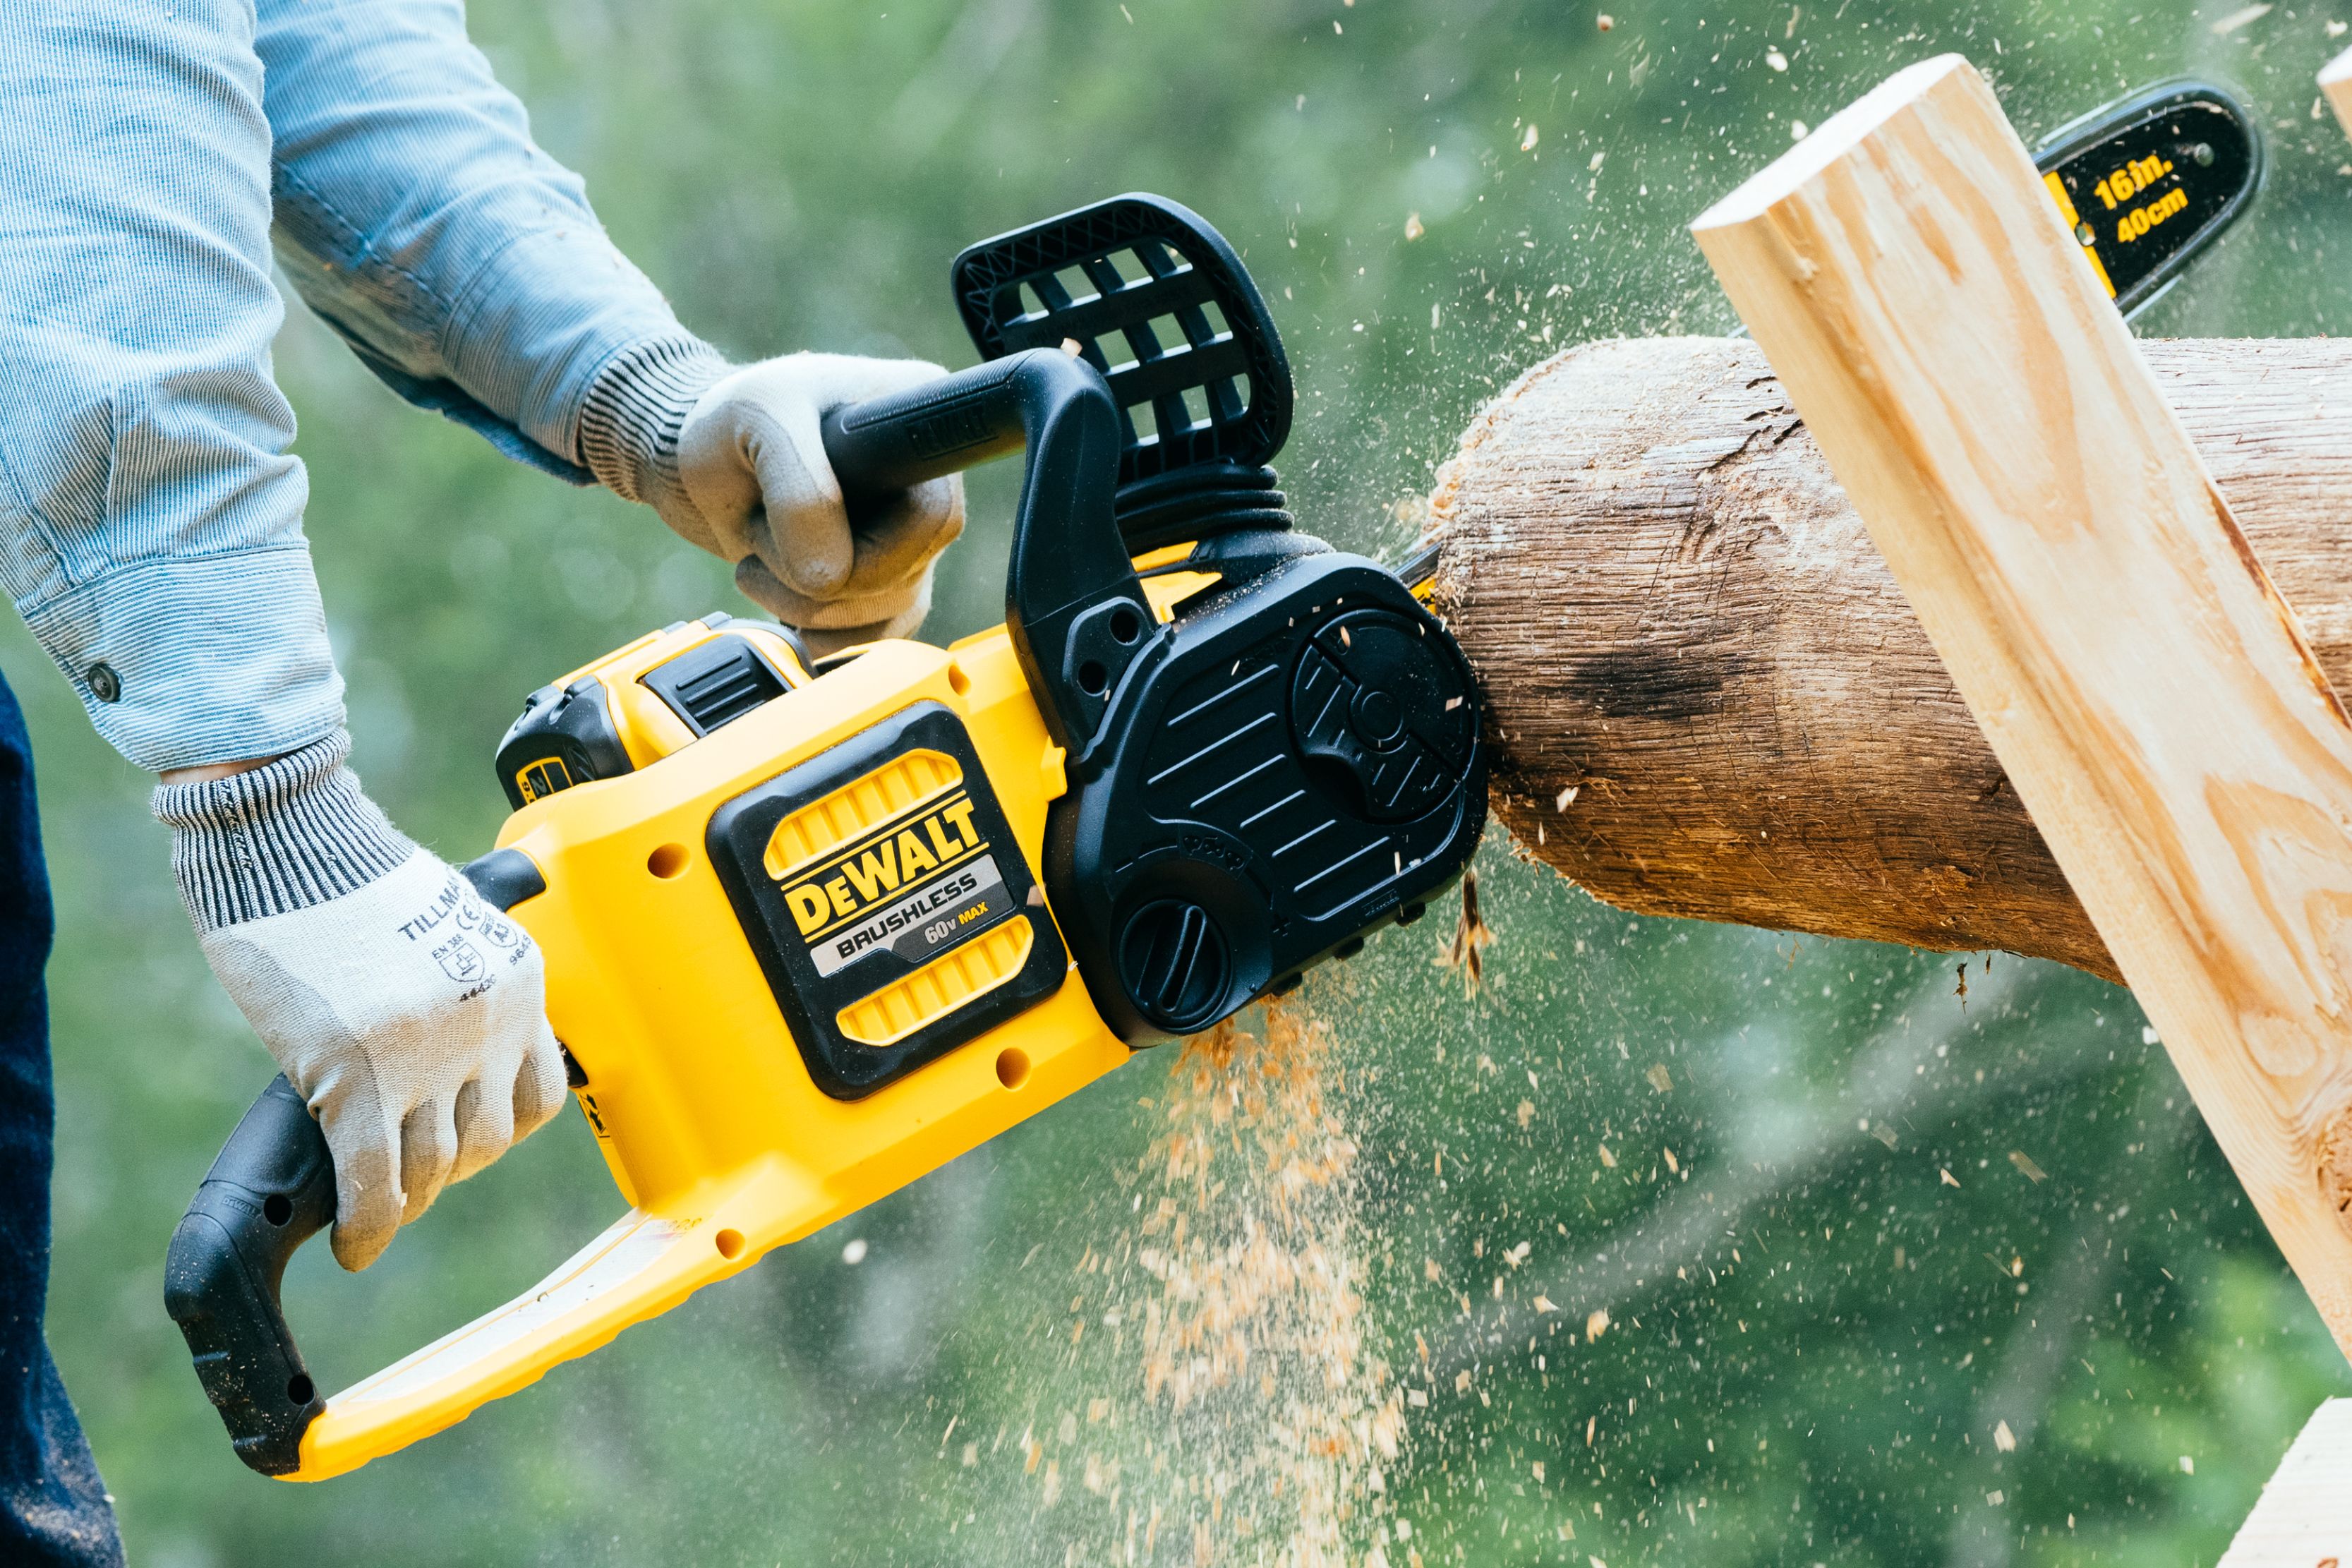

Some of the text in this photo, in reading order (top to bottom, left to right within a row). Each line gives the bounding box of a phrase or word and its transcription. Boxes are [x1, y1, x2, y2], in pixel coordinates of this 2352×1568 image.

[2094, 155, 2173, 210] 16in.
[2117, 188, 2189, 243] 40cm
[836, 873, 977, 960] BRUSHLESS
[958, 900, 989, 926] MAX
[431, 946, 449, 960] EN
